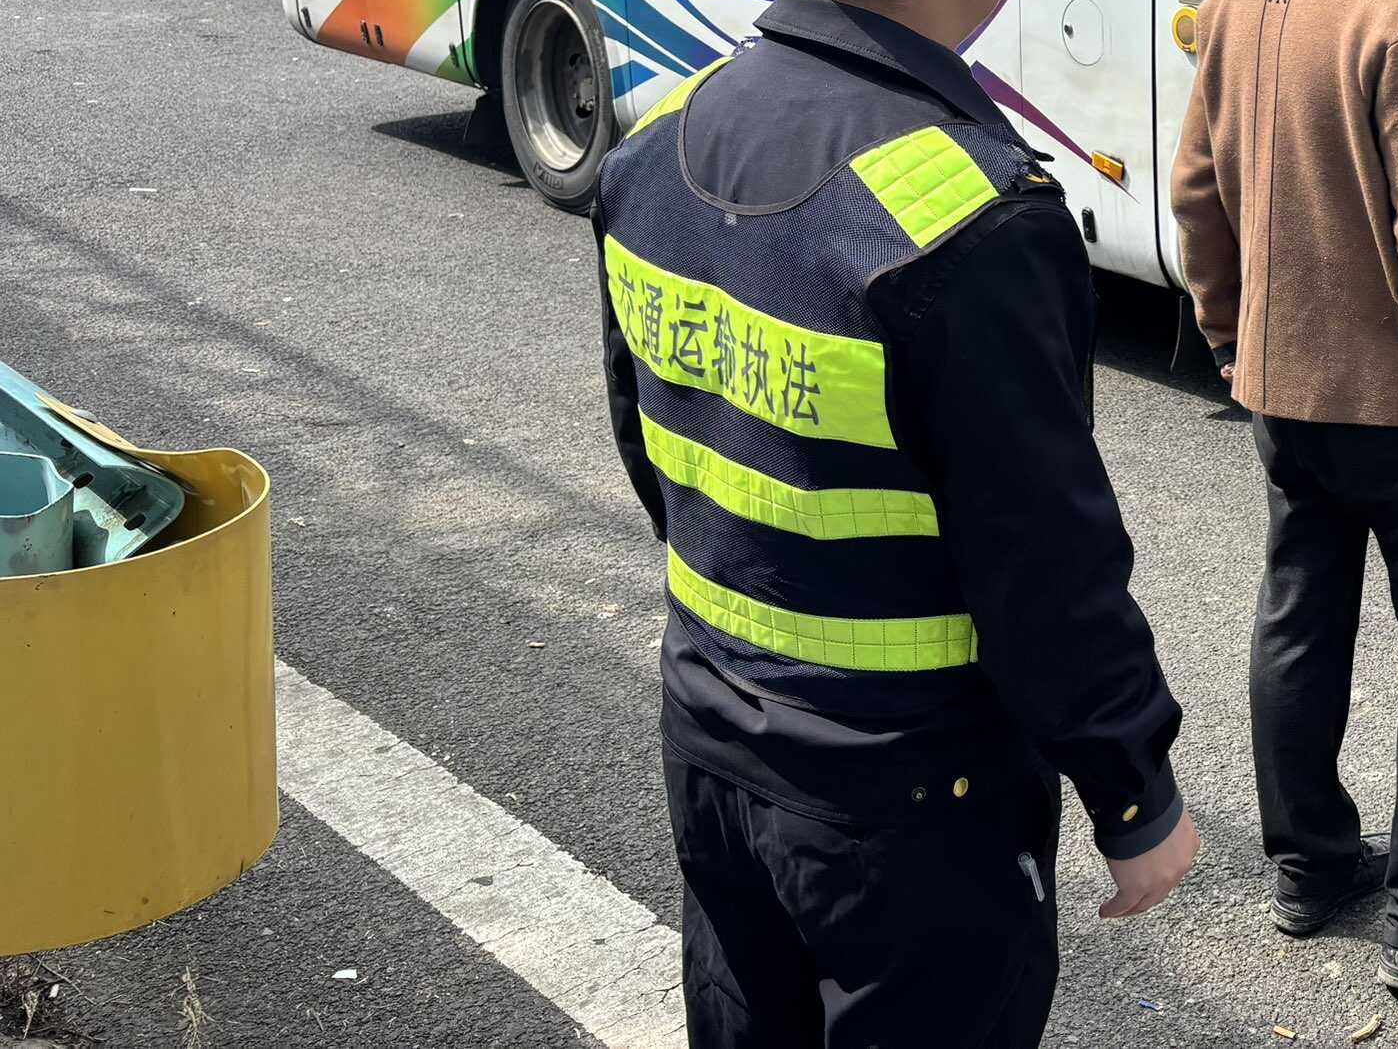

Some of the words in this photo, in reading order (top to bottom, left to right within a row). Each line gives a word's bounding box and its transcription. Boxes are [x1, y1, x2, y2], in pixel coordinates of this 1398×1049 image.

[617, 263, 820, 426] 交通运输执法
